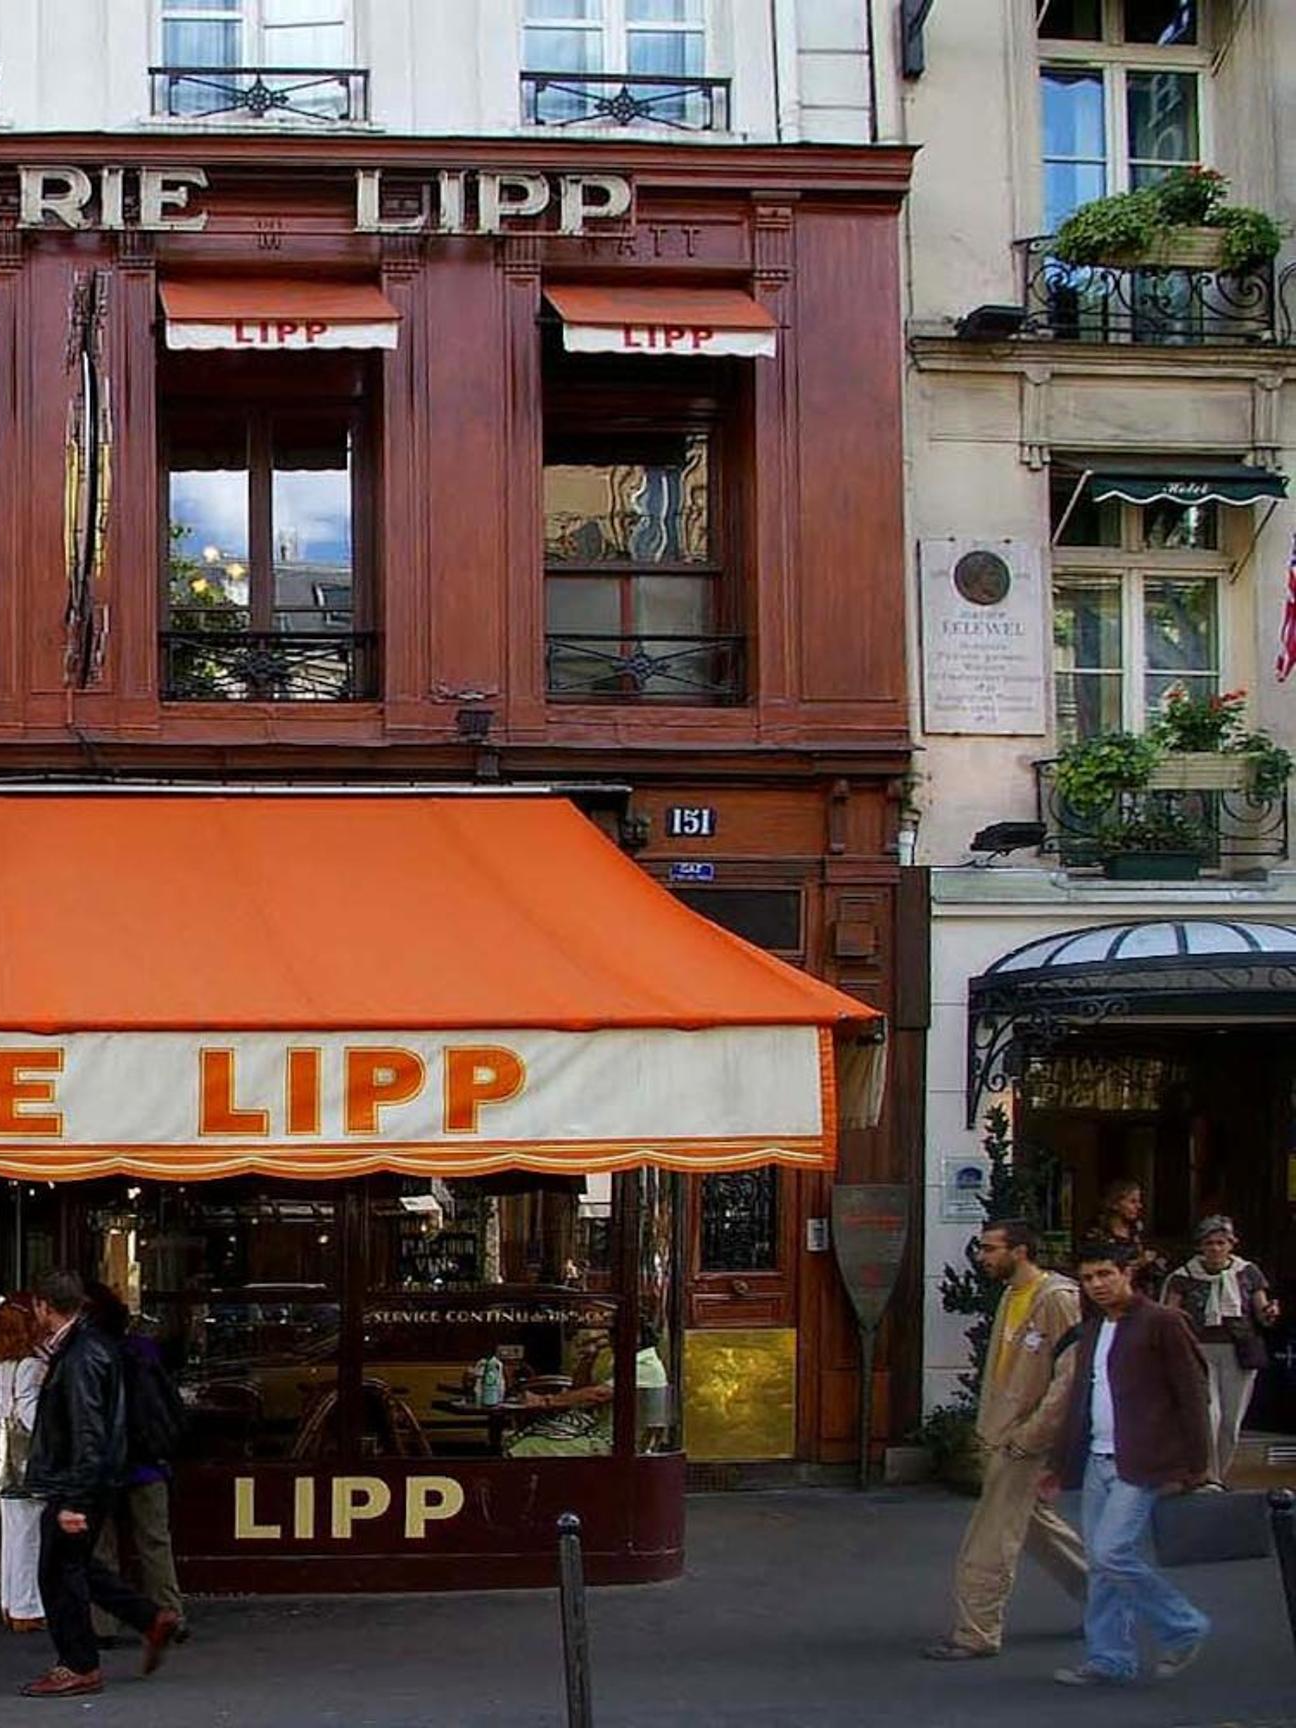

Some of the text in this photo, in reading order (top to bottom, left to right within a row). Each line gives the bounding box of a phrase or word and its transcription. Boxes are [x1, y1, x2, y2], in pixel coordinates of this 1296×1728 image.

[355, 168, 634, 236] LIPP
[235, 321, 328, 344] LIPP
[623, 324, 714, 349] LIPP
[672, 808, 711, 835] 151
[198, 1046, 527, 1137] LIPP
[373, 1309, 442, 1324] SERVICE
[445, 1308, 529, 1323] CONTINU
[234, 1475, 465, 1540] LIPP
